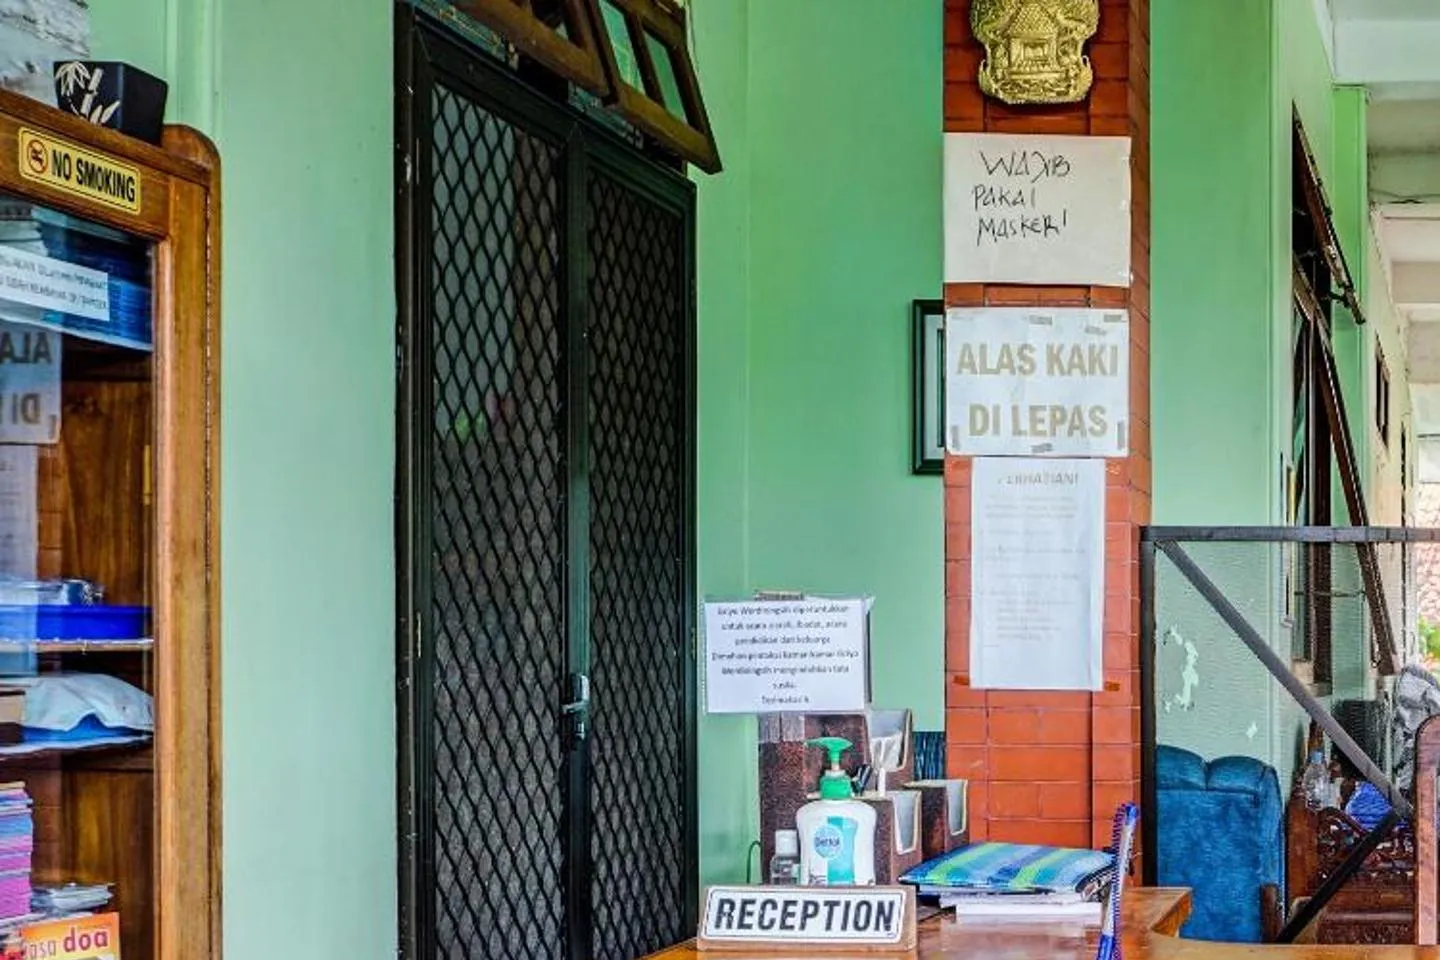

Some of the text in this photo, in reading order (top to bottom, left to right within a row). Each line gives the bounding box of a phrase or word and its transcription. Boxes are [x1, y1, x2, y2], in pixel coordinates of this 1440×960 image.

[51, 149, 137, 203] NO SMOKING
[980, 151, 1070, 183] WAJIB
[972, 184, 1036, 211] PAKAI
[956, 343, 1119, 376] ALAS KAKI
[968, 404, 1108, 438] DI LEPAS
[714, 898, 895, 932] RECEPTION
[62, 927, 109, 953] doa
